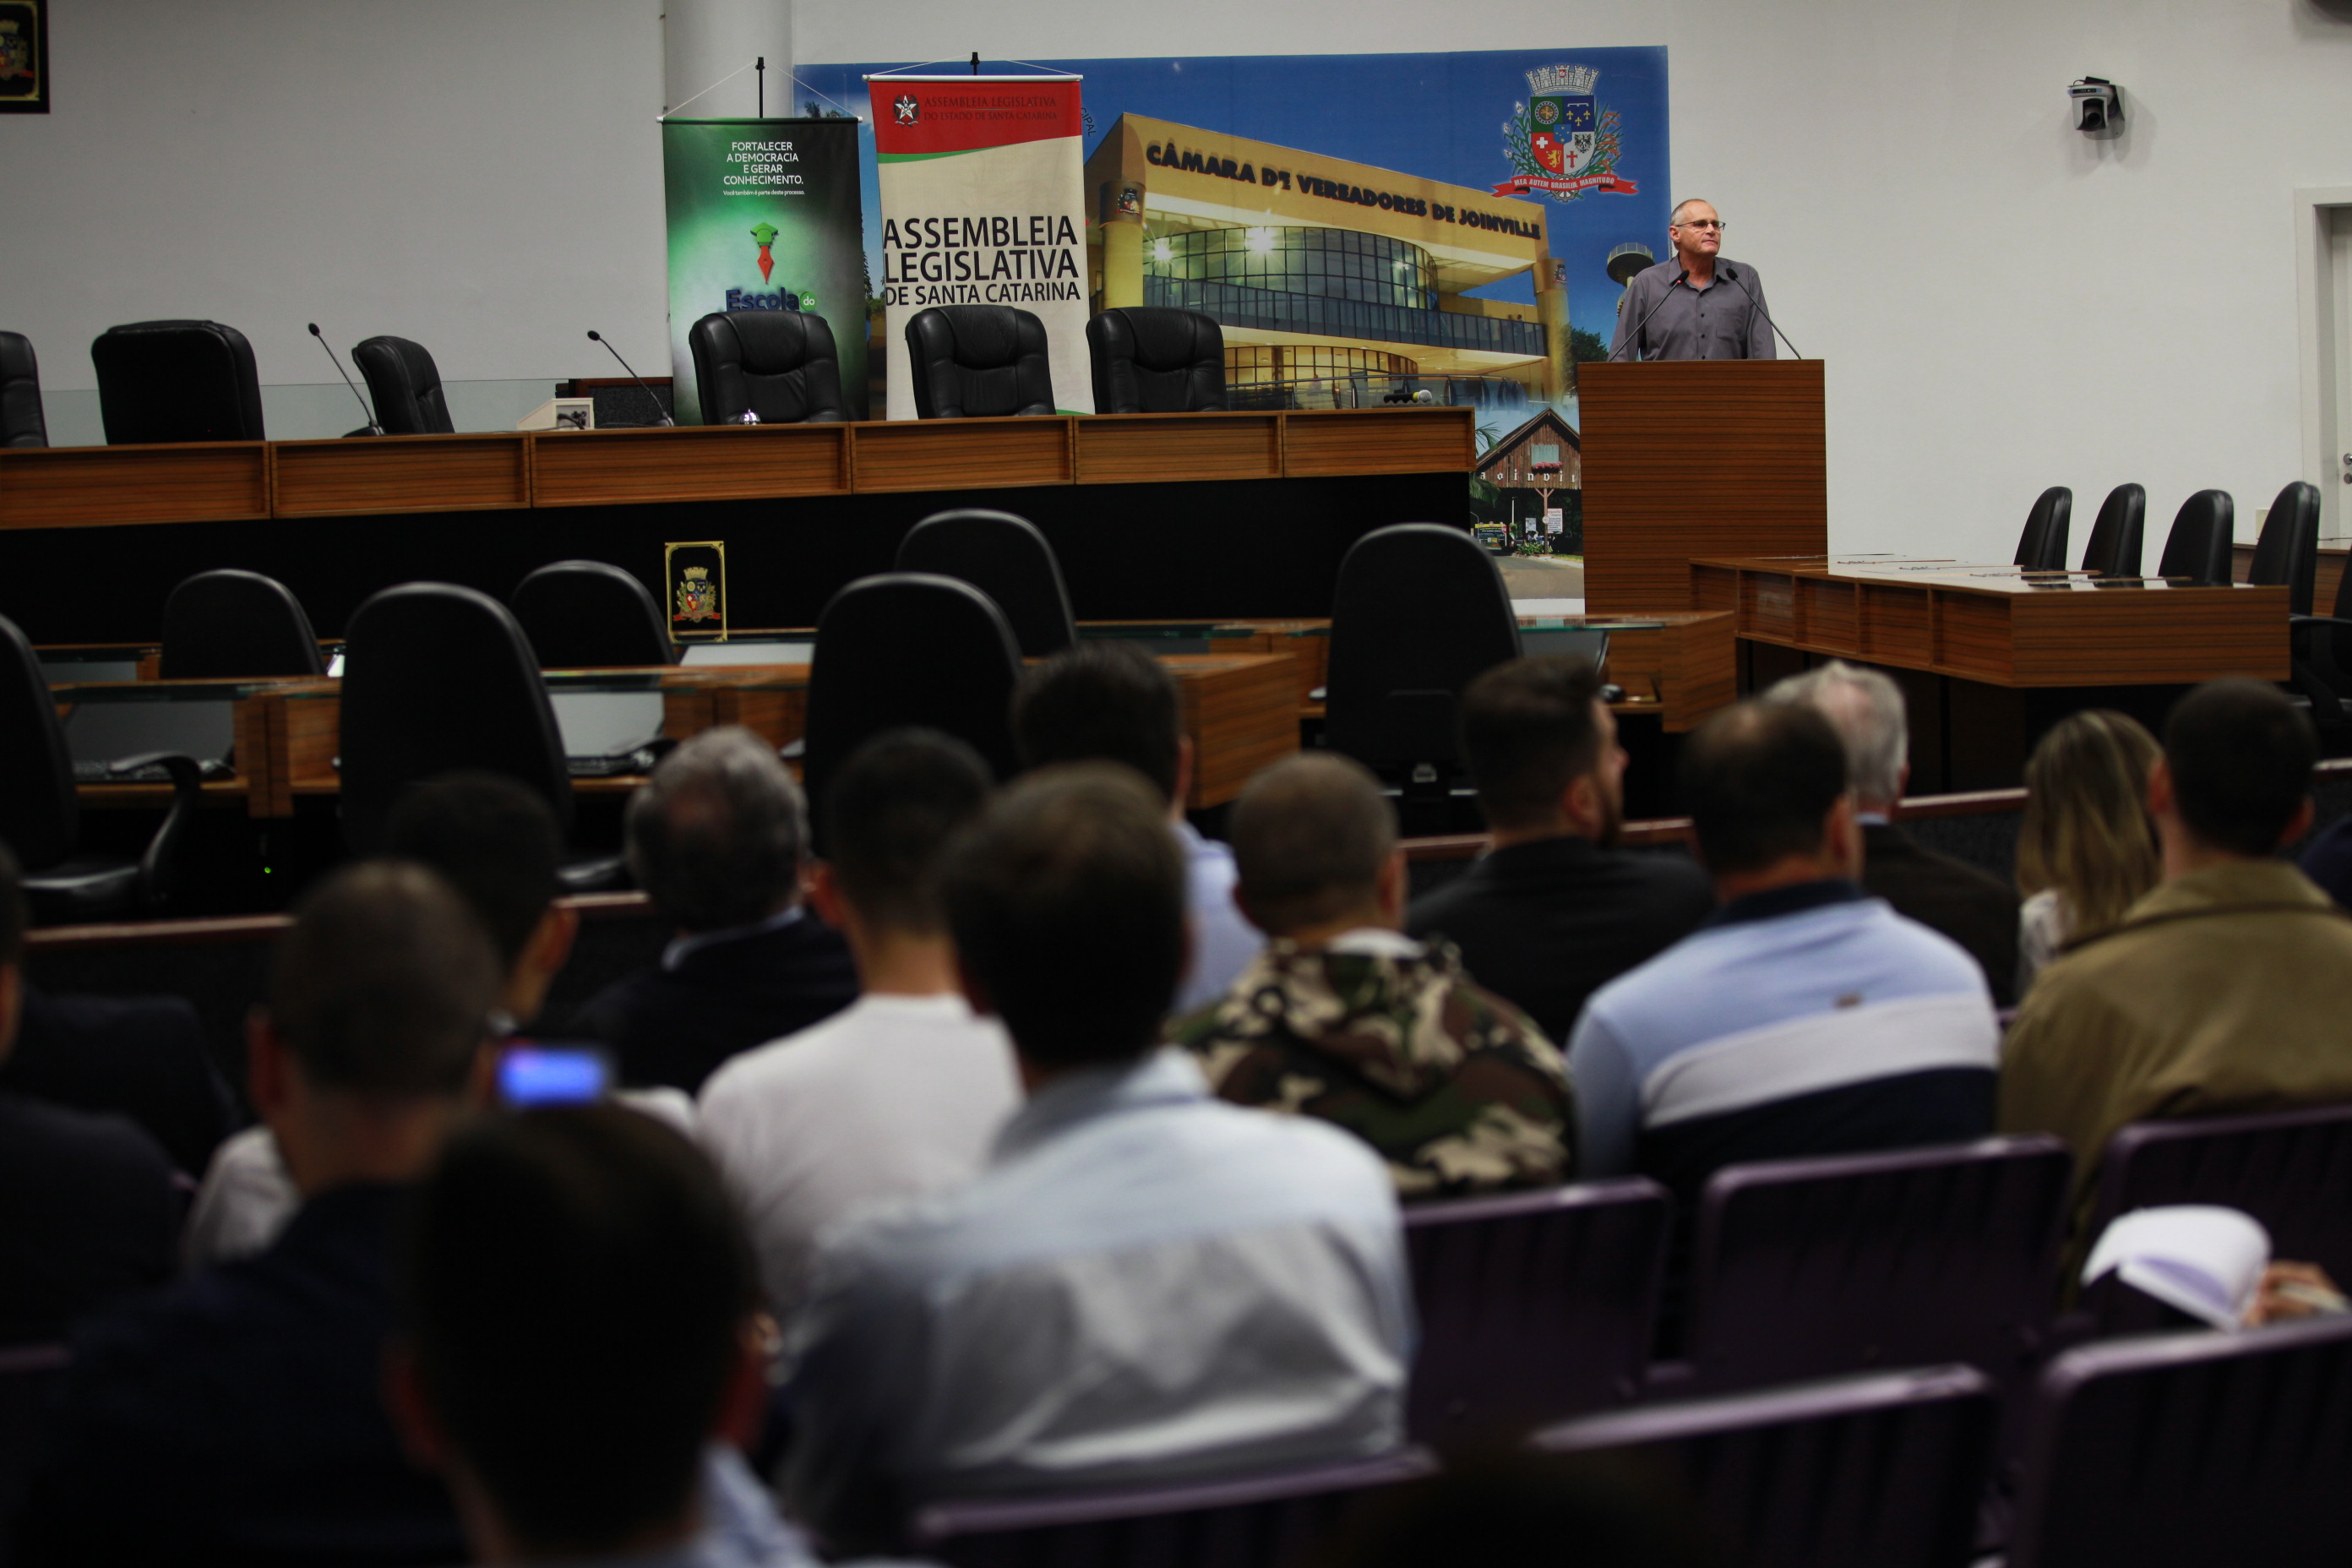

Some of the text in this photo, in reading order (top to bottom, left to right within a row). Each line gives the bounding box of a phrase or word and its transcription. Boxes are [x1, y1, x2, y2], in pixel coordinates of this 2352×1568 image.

[924, 96, 1056, 107] ASSEMBLEIA LEGISLATIVA
[924, 111, 1057, 120] DO ESTADO DE SANTA CATARINA
[1081, 107, 1096, 137] CIPAL
[732, 142, 793, 151] FORTALECER
[727, 153, 799, 162] A DEMOCRACIA
[743, 164, 783, 173] E GERAR
[723, 175, 803, 185] CONHECIMENTO.
[1528, 179, 1549, 188] AUTEM
[1580, 177, 1614, 187] MAGNITUDO
[1146, 142, 1256, 184] CÂMARA
[1296, 173, 1428, 217] VEREADORES
[1432, 204, 1456, 223] DE
[1458, 209, 1541, 240] JOINVILLE
[884, 215, 1078, 249] ASSEMBLEIA
[885, 248, 1079, 283] LEGISLATIVA
[726, 286, 815, 311] Escola do
[886, 281, 1081, 306] DE SANTA CATARINA
